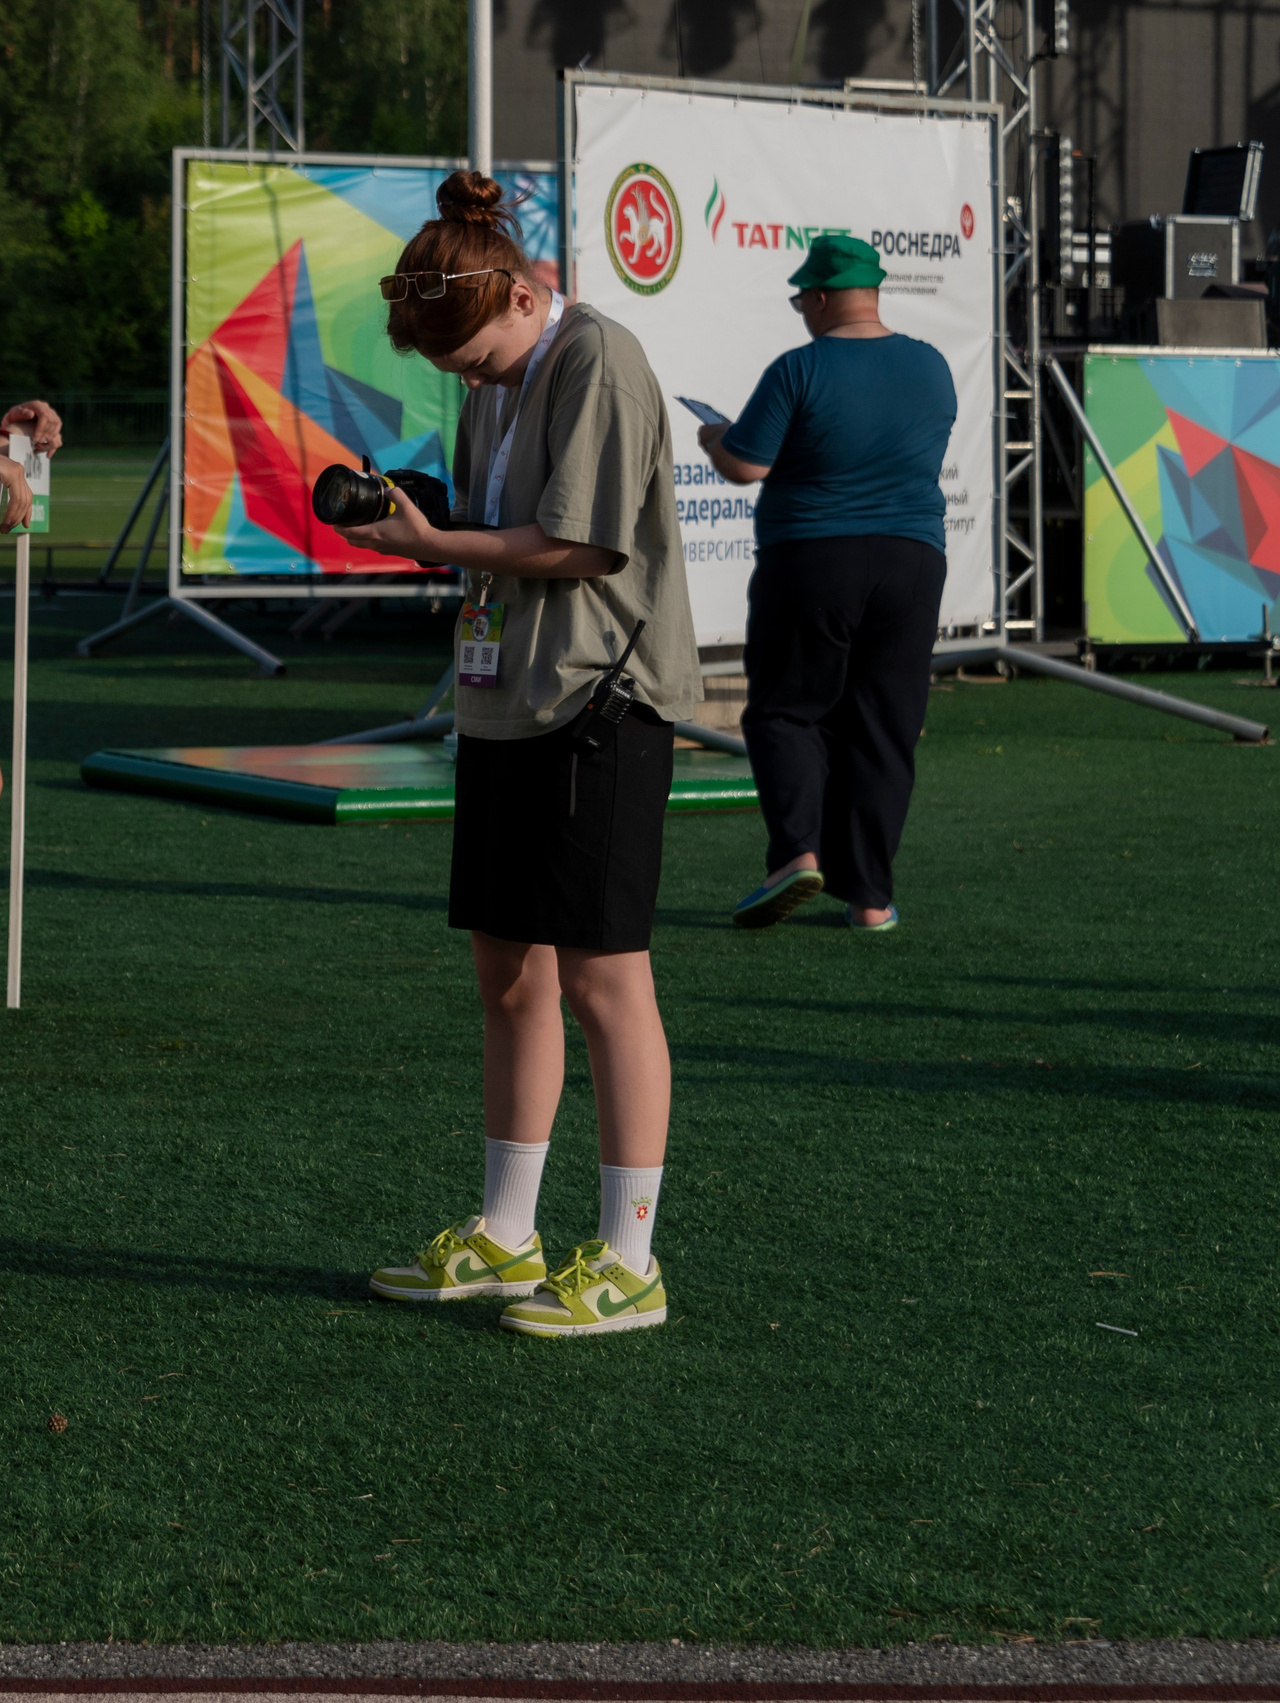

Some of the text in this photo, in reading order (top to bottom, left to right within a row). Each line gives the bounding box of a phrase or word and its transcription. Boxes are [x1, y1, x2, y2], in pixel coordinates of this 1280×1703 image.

[871, 230, 961, 261] РОСНЕДРА
[939, 463, 959, 480] кий
[945, 483, 968, 506] ный
[676, 498, 755, 528] едераль
[944, 517, 975, 536] ститут
